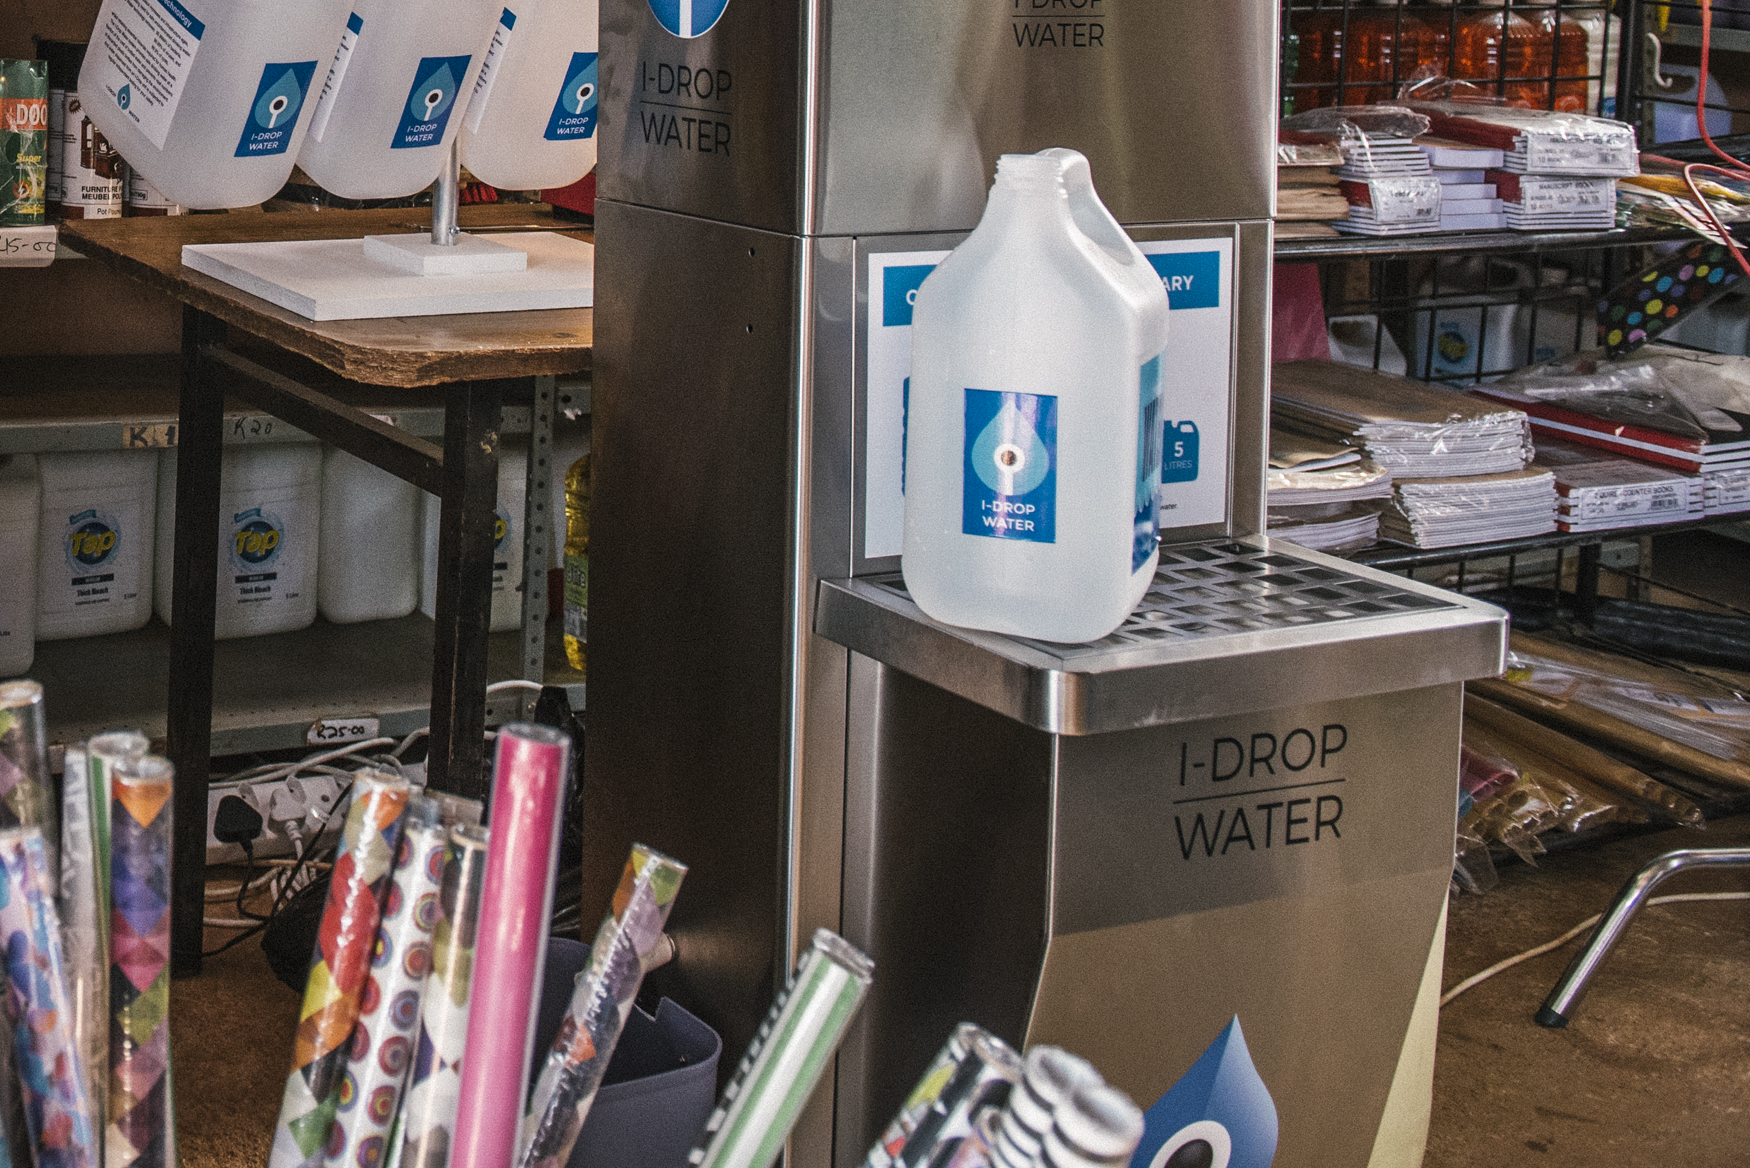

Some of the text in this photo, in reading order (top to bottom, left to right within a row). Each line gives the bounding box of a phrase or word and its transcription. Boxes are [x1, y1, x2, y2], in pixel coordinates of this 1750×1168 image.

[1012, 22, 1104, 48] WATER
[641, 60, 732, 99] I-DROP
[406, 124, 438, 134] I-DROP
[558, 117, 588, 126] I-DROP
[250, 132, 282, 142] I-DROP
[404, 134, 434, 143] WATER
[556, 126, 585, 136] WATER
[640, 110, 731, 156] WATER
[249, 141, 280, 151] WATER
[1174, 441, 1184, 458] 5
[1623, 488, 1651, 496] COUNTER
[1653, 486, 1674, 494] BOOKS
[981, 500, 1035, 516] I-DROP
[982, 516, 1035, 532] WATER
[69, 530, 116, 556] Tap
[234, 530, 280, 556] Tap
[1178, 723, 1348, 787] I-DROP
[1174, 794, 1344, 861] WATER
